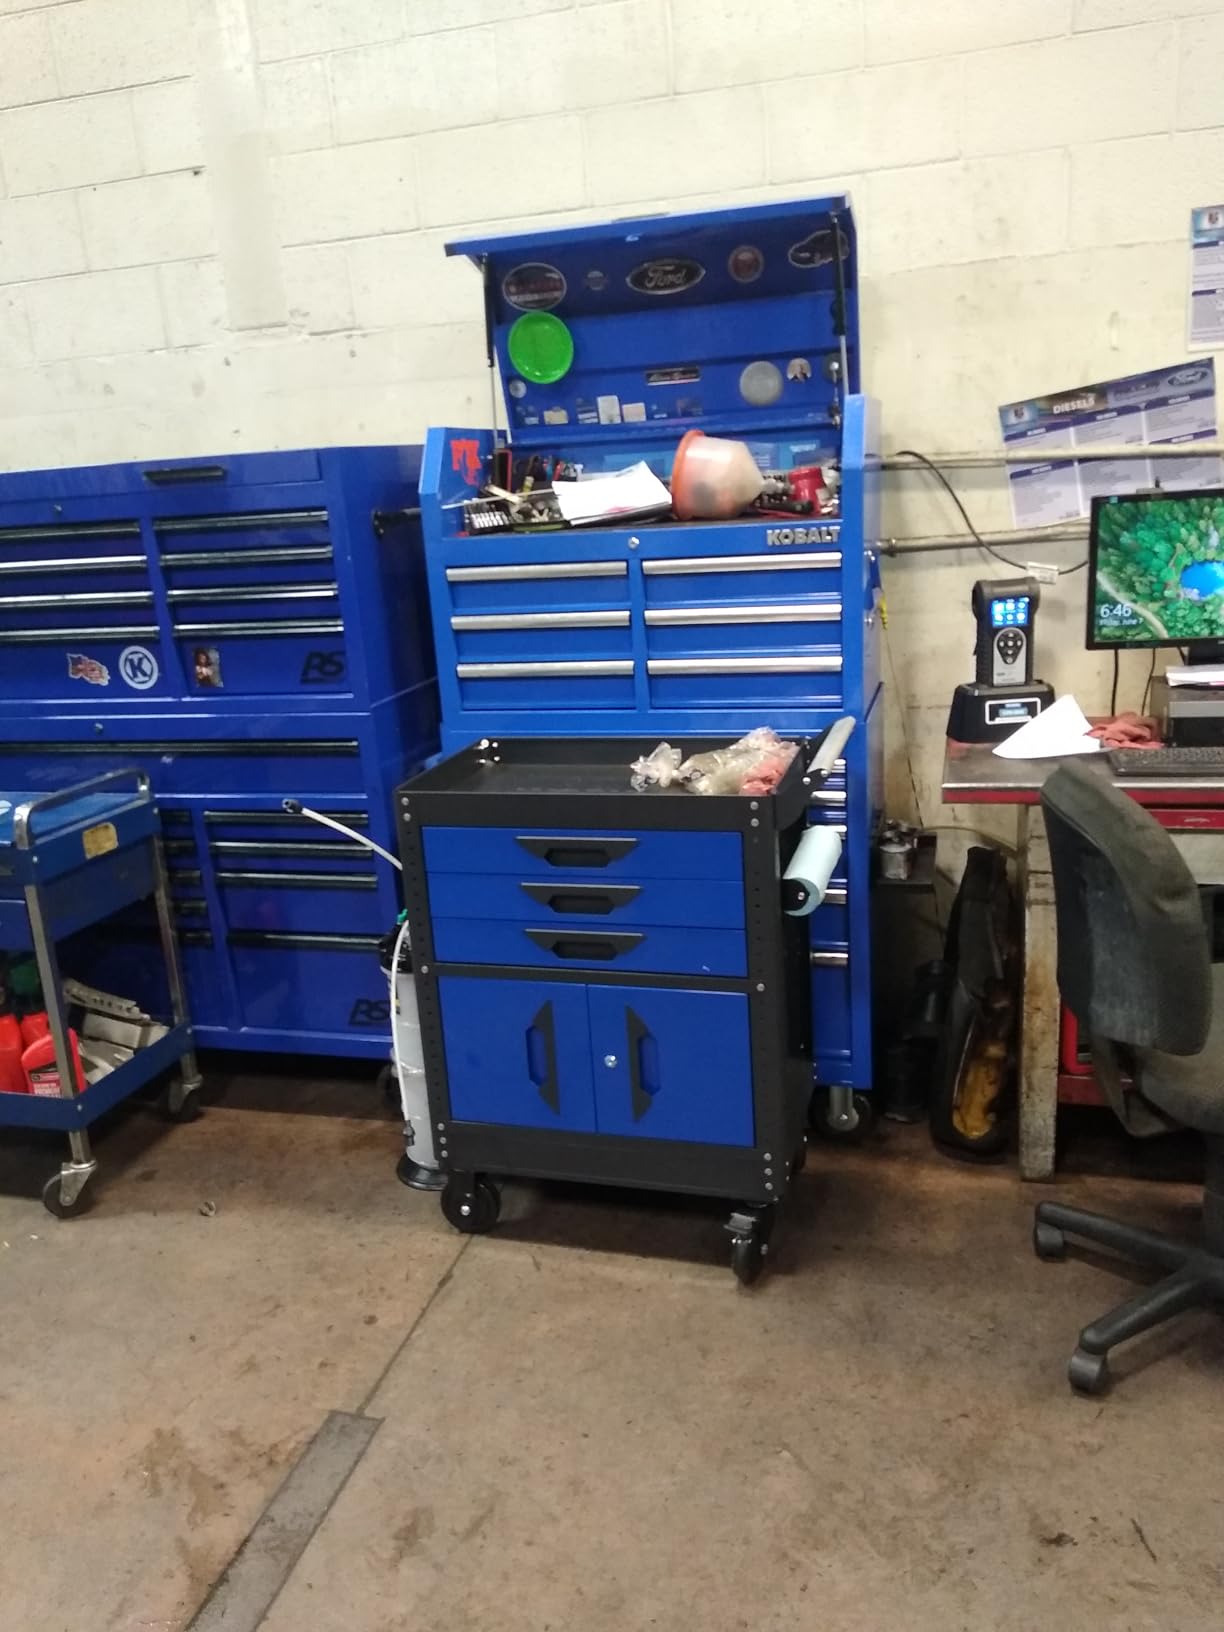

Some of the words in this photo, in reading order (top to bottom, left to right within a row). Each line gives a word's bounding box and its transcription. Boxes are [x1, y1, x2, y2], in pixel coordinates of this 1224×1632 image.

[645, 264, 686, 288] Ford
[1053, 396, 1095, 416] DIESELS
[766, 526, 841, 546] KOBALT
